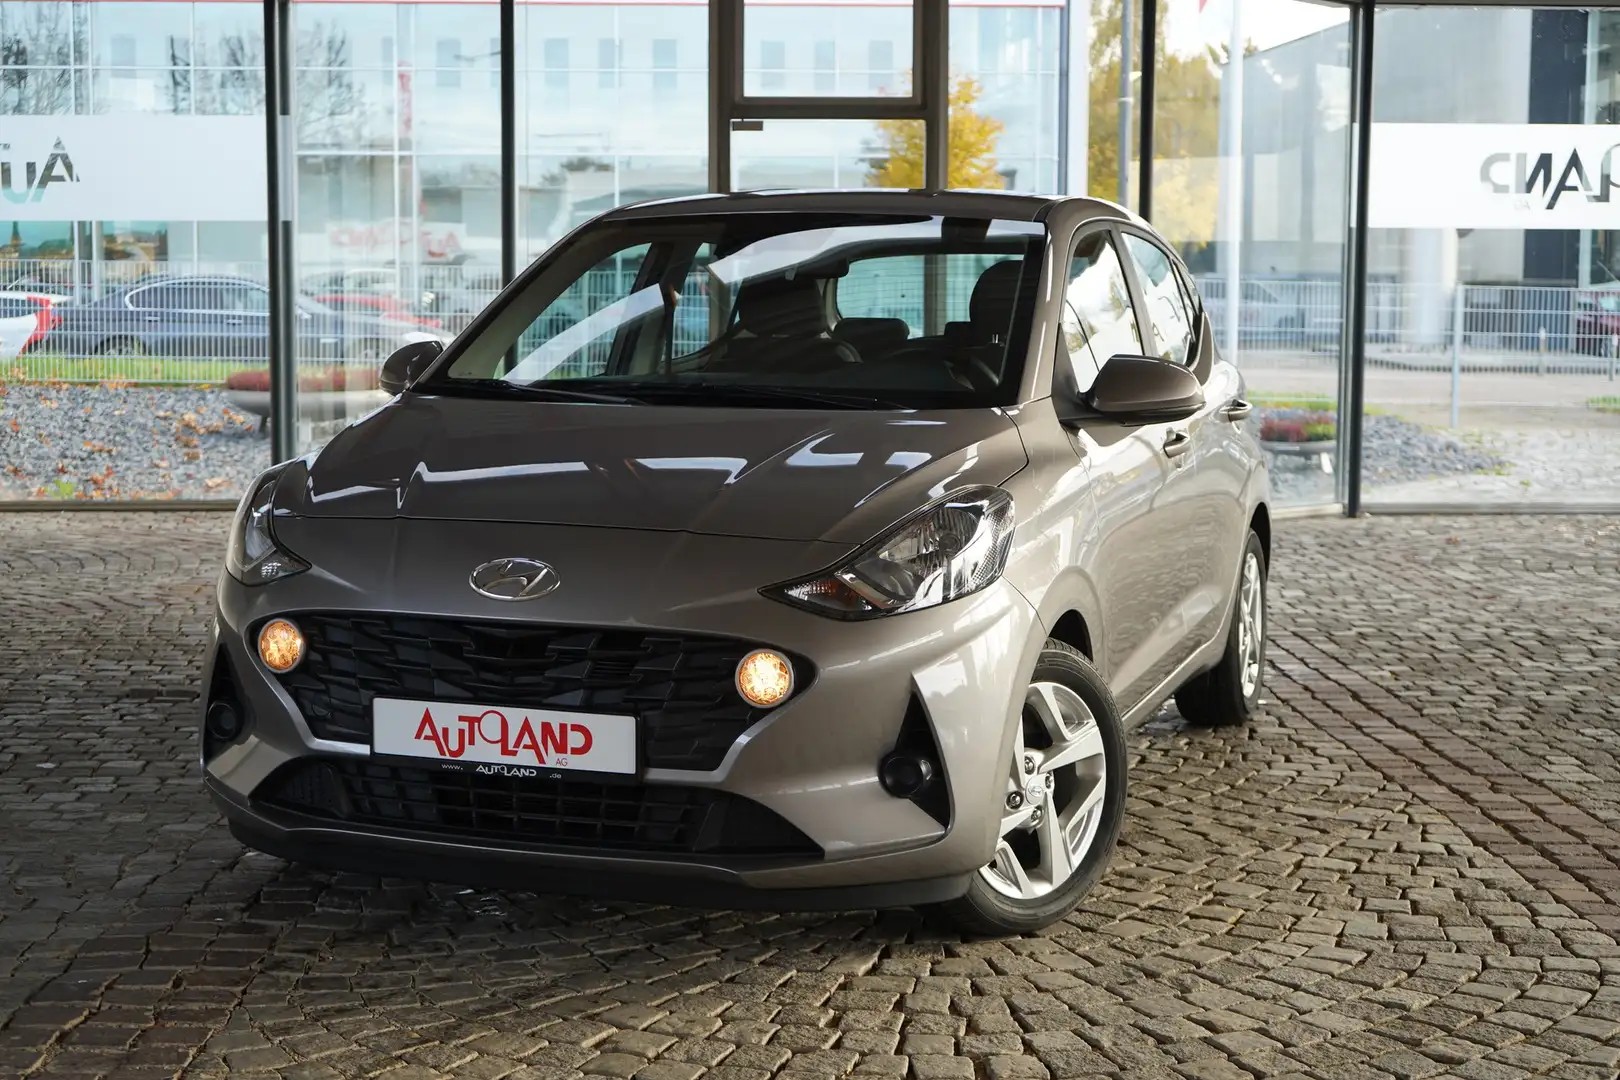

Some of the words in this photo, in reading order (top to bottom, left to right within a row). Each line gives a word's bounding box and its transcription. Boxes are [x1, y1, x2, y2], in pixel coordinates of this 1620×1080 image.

[414, 707, 593, 765] AUTOLAND
[555, 757, 568, 767] AG
[476, 764, 537, 777] AUTOLAND
